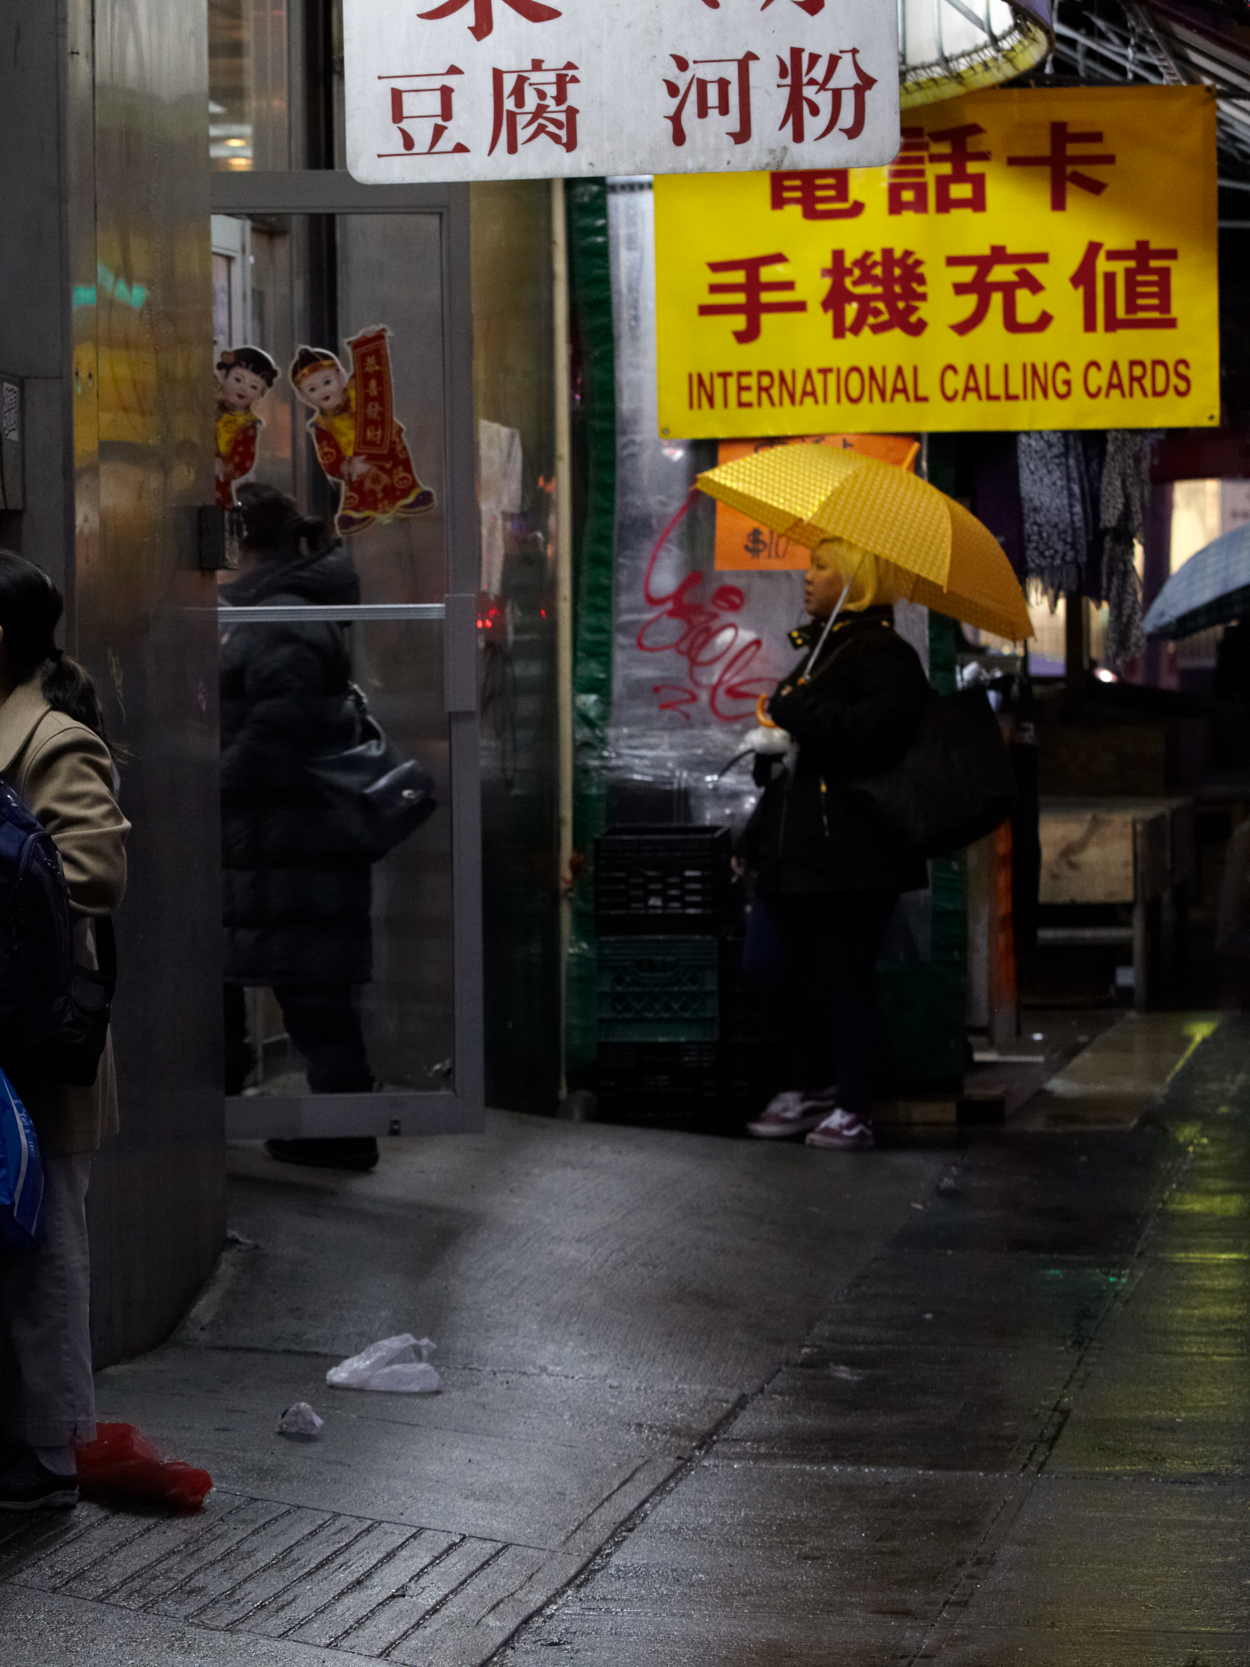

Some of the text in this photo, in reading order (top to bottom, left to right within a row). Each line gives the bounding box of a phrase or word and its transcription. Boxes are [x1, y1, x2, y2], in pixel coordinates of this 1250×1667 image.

[377, 47, 878, 158] 豆腐 河粉
[688, 358, 1191, 411] INTERNATIONAL CALLING CARDS
